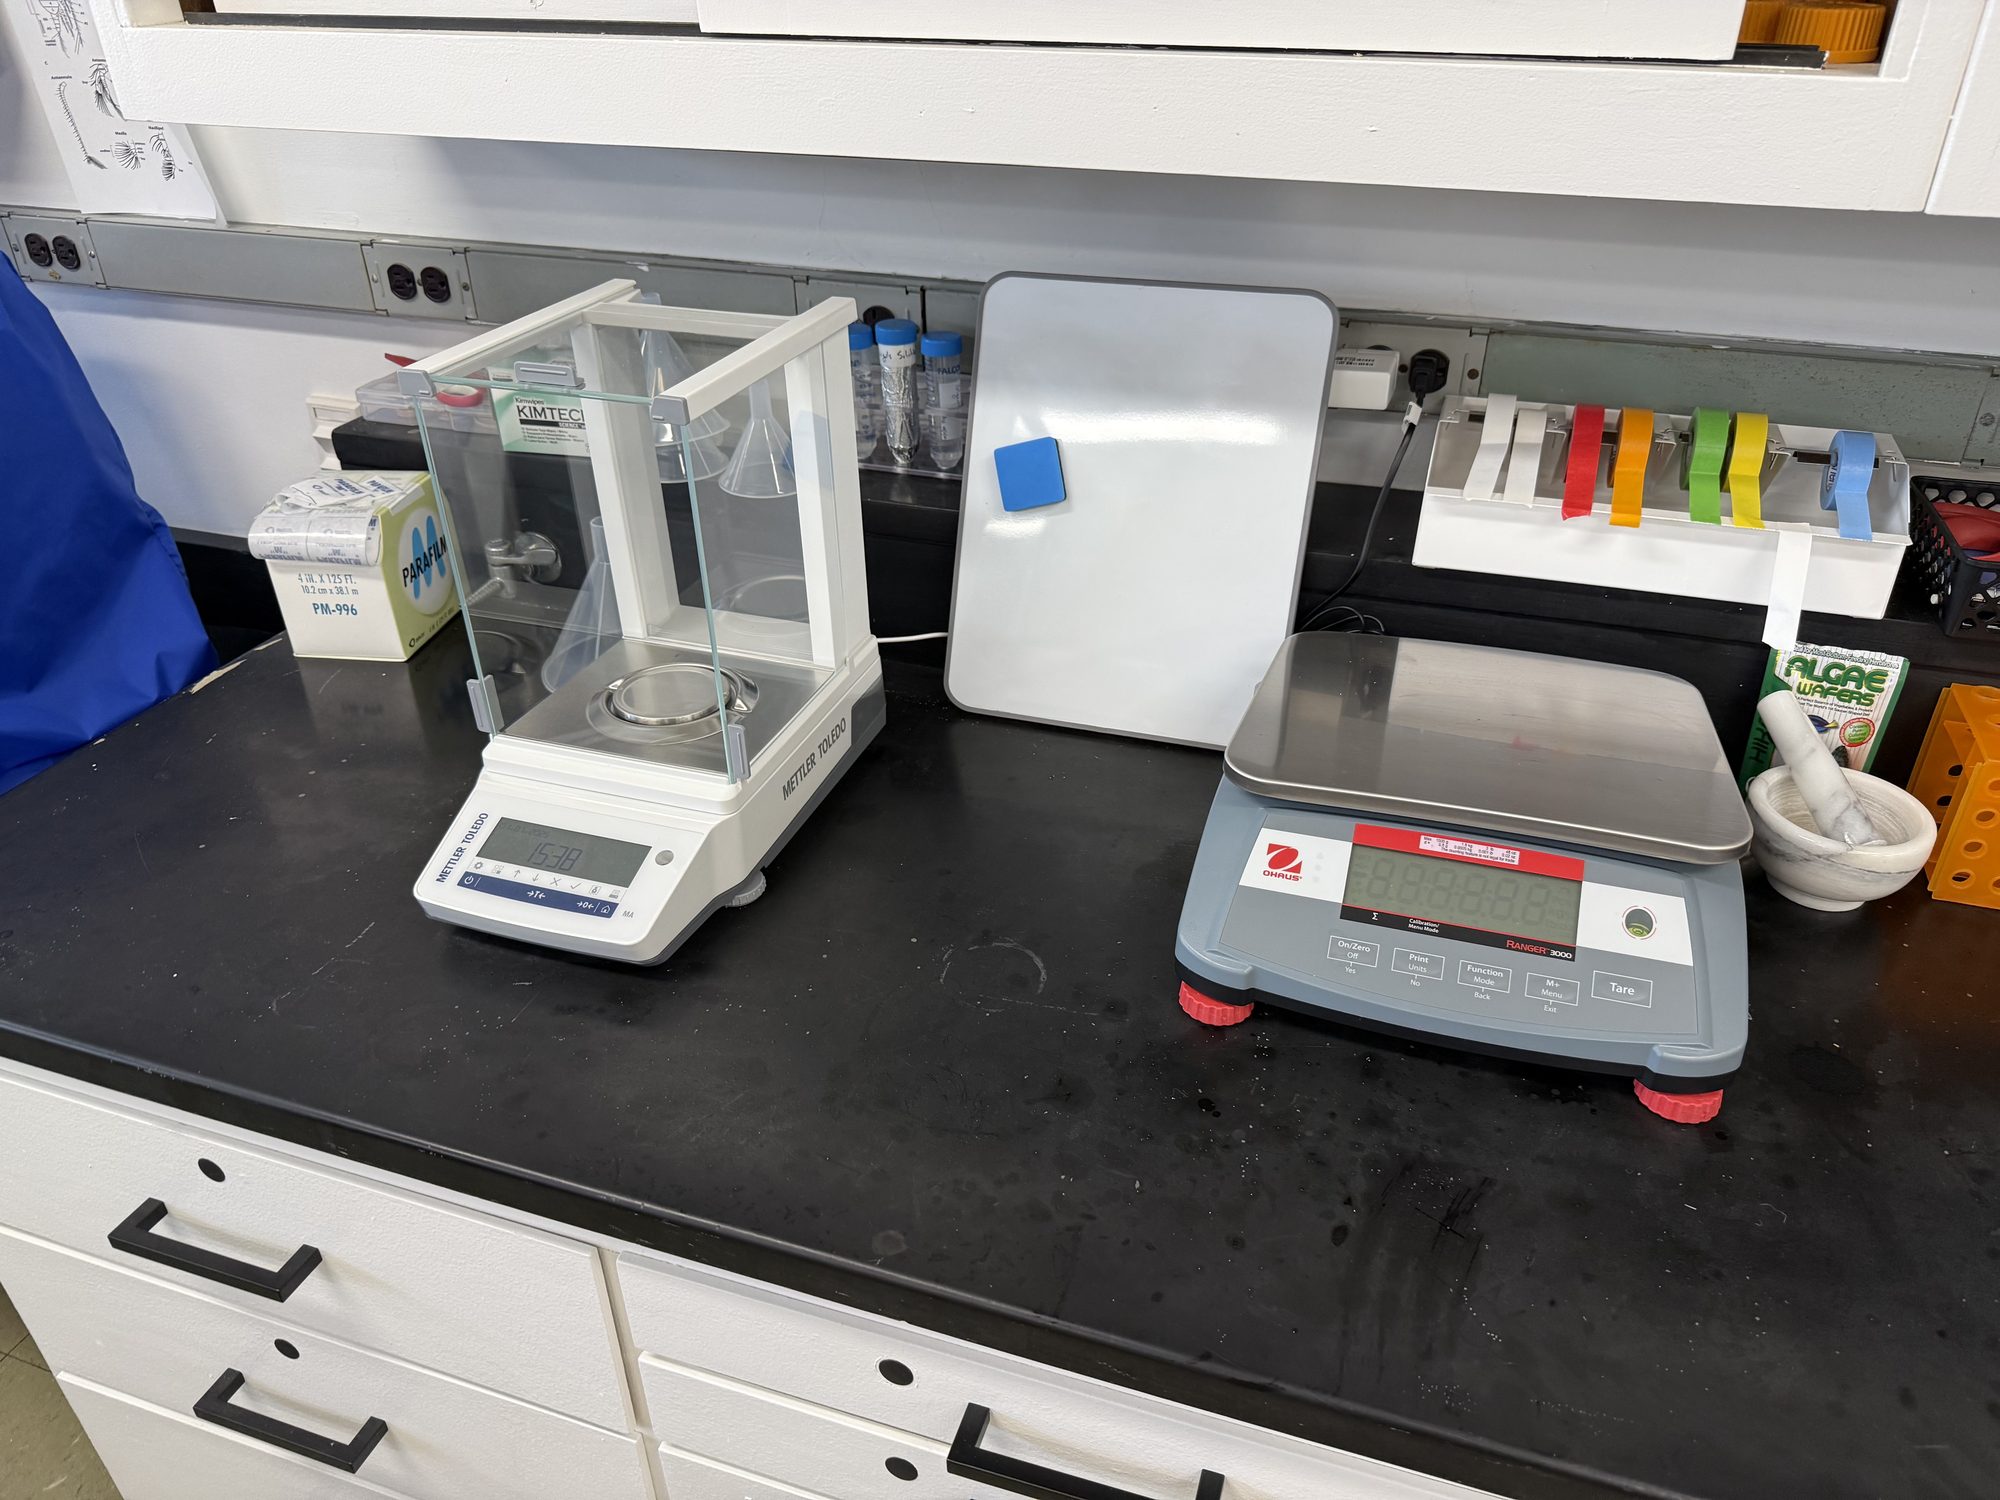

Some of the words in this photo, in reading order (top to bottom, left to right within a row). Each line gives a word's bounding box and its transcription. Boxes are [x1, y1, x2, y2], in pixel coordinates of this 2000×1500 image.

[515, 396, 545, 406] Kimwipes
[327, 574, 343, 584] 125
[344, 574, 357, 584] FT.
[301, 585, 316, 594] 10.2
[335, 585, 350, 595] 38.1
[312, 603, 358, 616] PM-996
[1784, 655, 1889, 693] ALGAE
[1796, 681, 1876, 707] WAFERS
[781, 752, 817, 801] METTLER
[818, 717, 847, 759] TOLEDO
[435, 846, 467, 883] METTLER
[461, 812, 489, 844] TOLEDO
[622, 910, 635, 919] MA
[1408, 918, 1440, 928] Calibration/
[1408, 923, 1423, 932] Menu
[1424, 926, 1440, 934] Mode
[1337, 940, 1371, 953] On/Zero
[1346, 952, 1359, 960] Off
[1409, 953, 1429, 964] Print
[1550, 949, 1573, 960] 3000
[1344, 966, 1357, 974] Yes
[1408, 963, 1427, 973] Units
[1467, 964, 1504, 978] Function
[1410, 979, 1421, 987] No
[1473, 975, 1495, 986] Mode
[1546, 979, 1561, 988] M+
[1541, 988, 1563, 999] Menu
[1609, 981, 1635, 996] Tare
[1474, 991, 1491, 1001] Back
[1543, 1004, 1557, 1013] Exit
